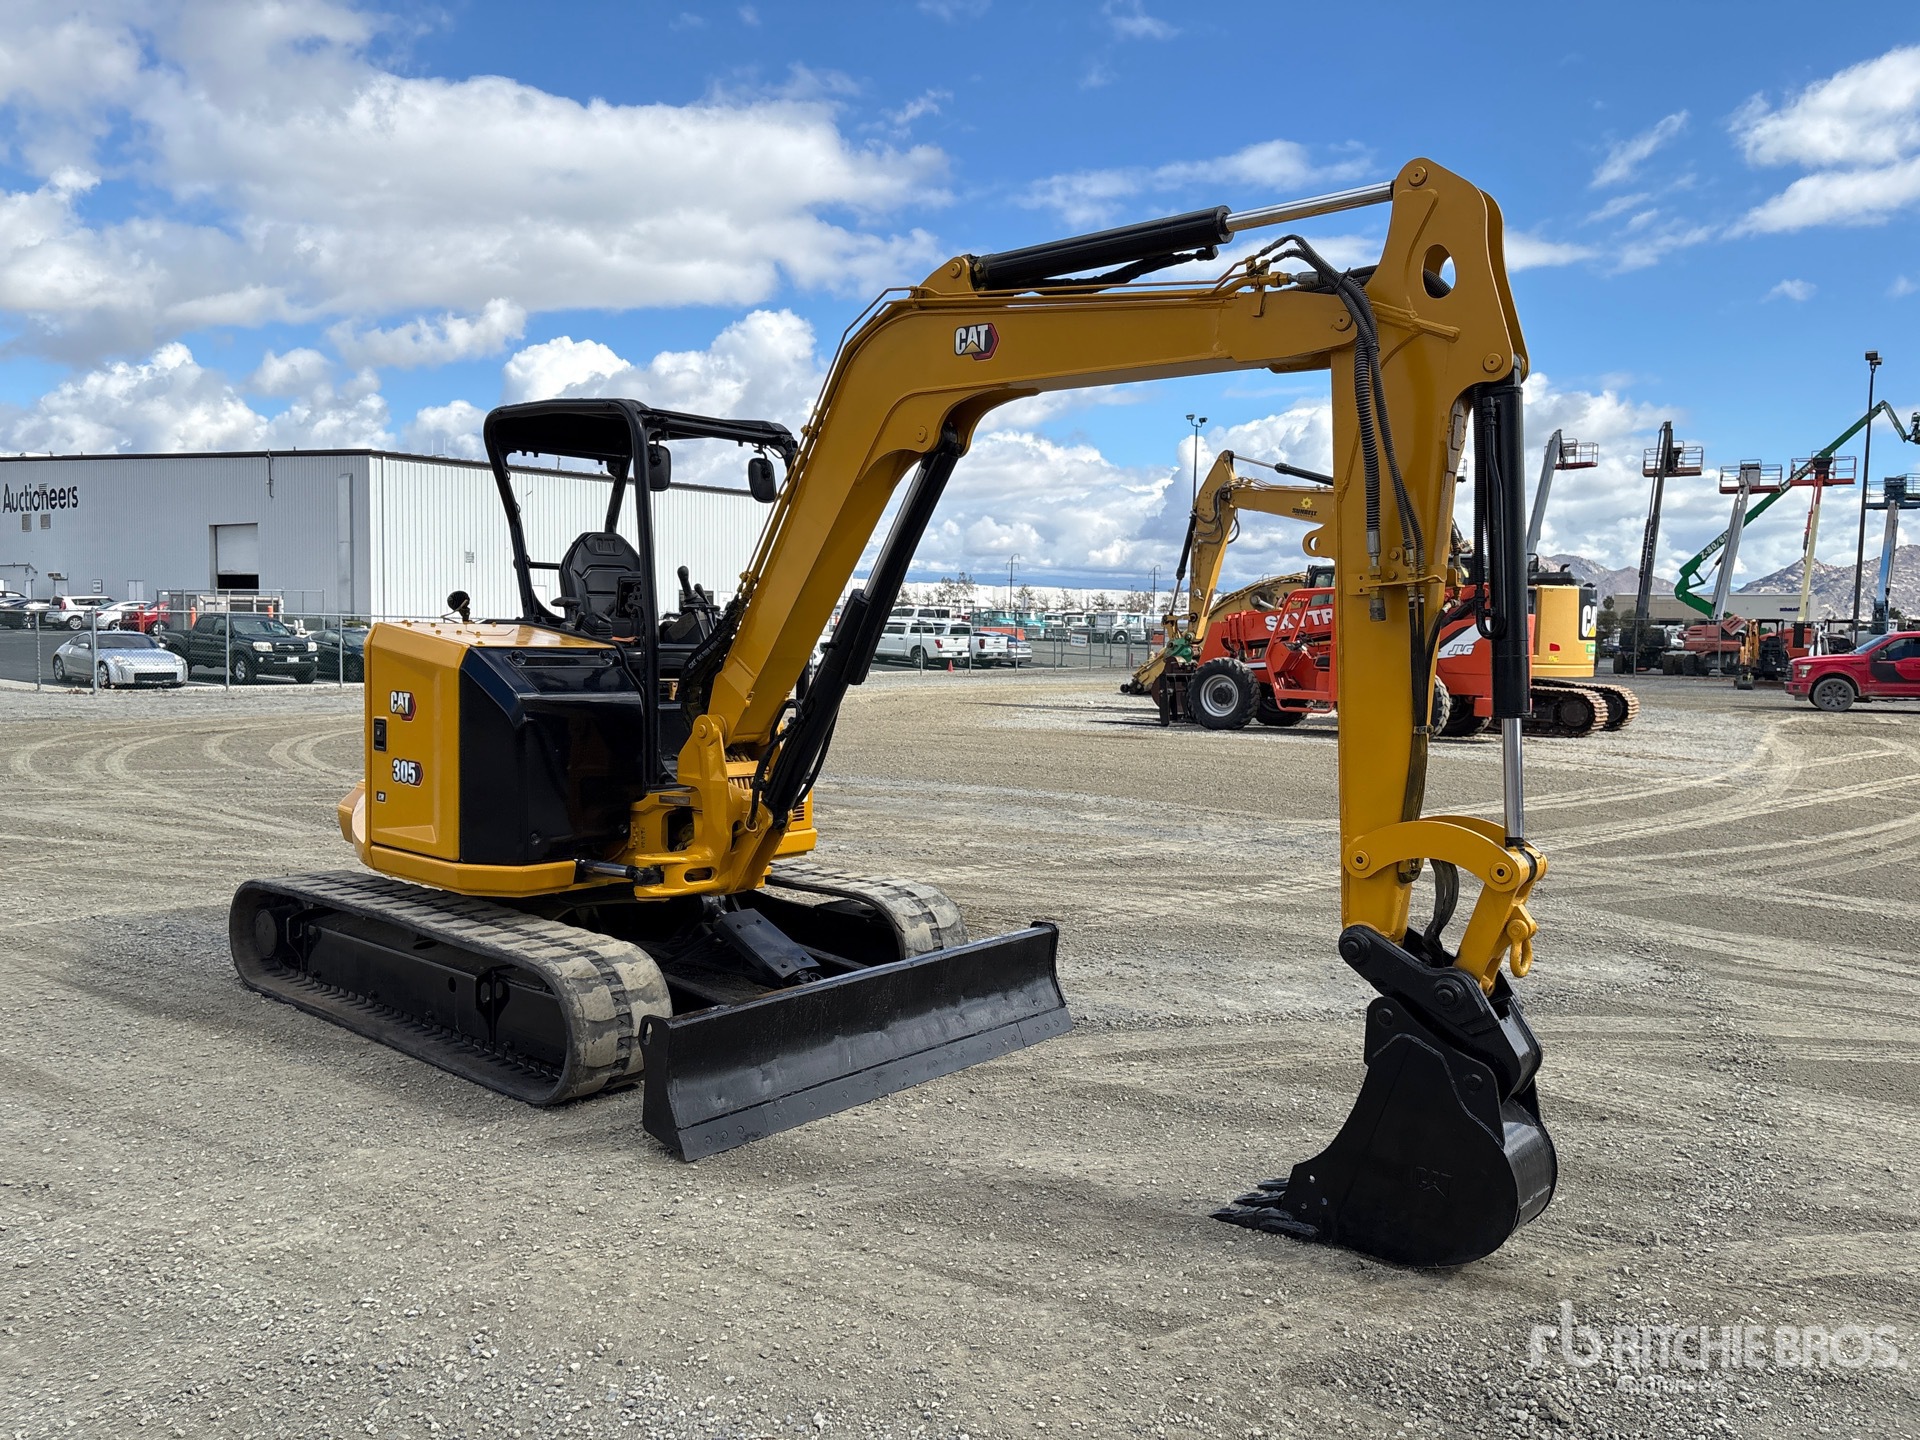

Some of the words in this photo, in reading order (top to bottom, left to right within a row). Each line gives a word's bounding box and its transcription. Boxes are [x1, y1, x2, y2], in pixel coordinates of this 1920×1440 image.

[955, 324, 989, 355] CAT
[2, 483, 79, 514] Auctioneers
[1447, 643, 1475, 656] JLG
[390, 691, 410, 715] CAT
[392, 759, 416, 785] 305
